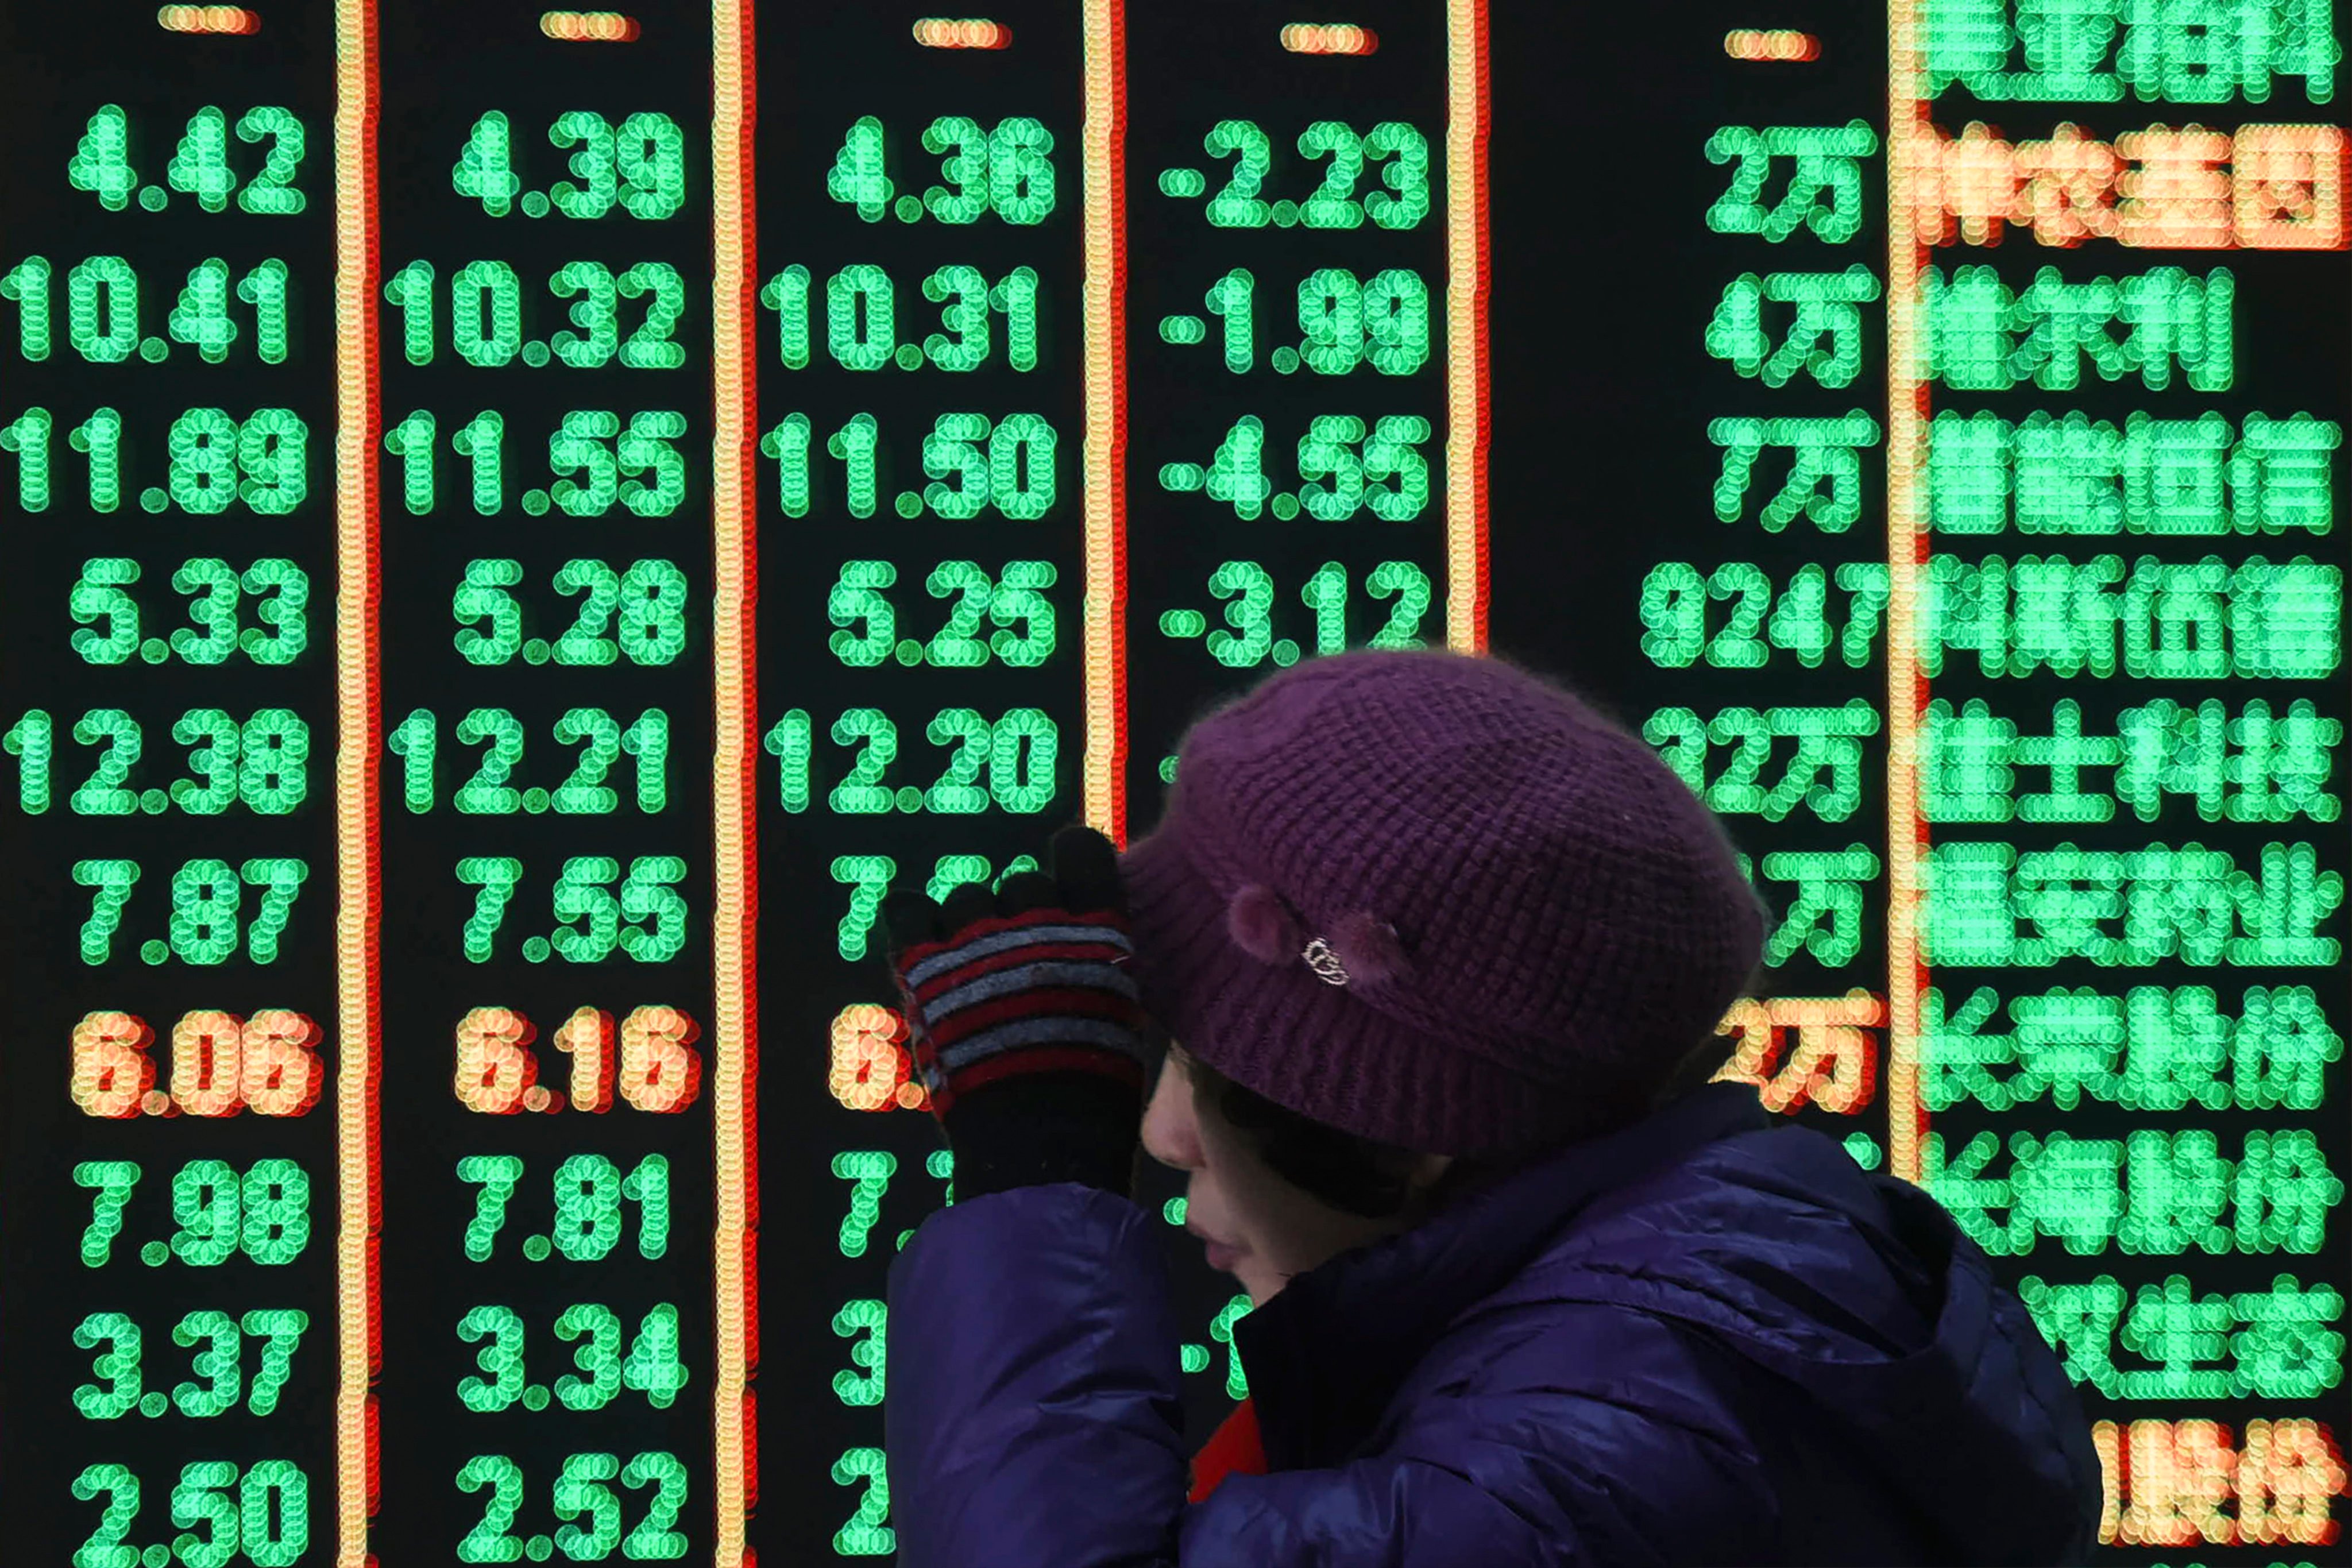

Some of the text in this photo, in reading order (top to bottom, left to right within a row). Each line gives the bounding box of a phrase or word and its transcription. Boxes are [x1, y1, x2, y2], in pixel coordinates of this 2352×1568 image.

[68, 104, 1430, 230] 4.42 4.39 4.36 -2.23
[1704, 118, 1879, 244] 2万
[0, 255, 1430, 376] 10.41 10.32 10.31 -1.99
[1705, 263, 1882, 389] 4万
[0, 407, 1431, 522] 11.89 11.55 11.50 -4.55
[1707, 408, 1882, 534] 7万
[69, 558, 1890, 669] 5.33 5.28 5.25 -3.12 9247
[2, 708, 1058, 815] 12.38 12.21 12.20
[72, 856, 688, 965] 7.87 7.55
[71, 1009, 315, 1117] 6.06
[454, 1003, 695, 1113] 6.16
[73, 1153, 670, 1268] 7.98 7.81
[72, 1309, 309, 1419] 3.37
[457, 1303, 689, 1412] 3.34
[71, 1459, 308, 1568] 2.50
[455, 1451, 689, 1563] 2.52
